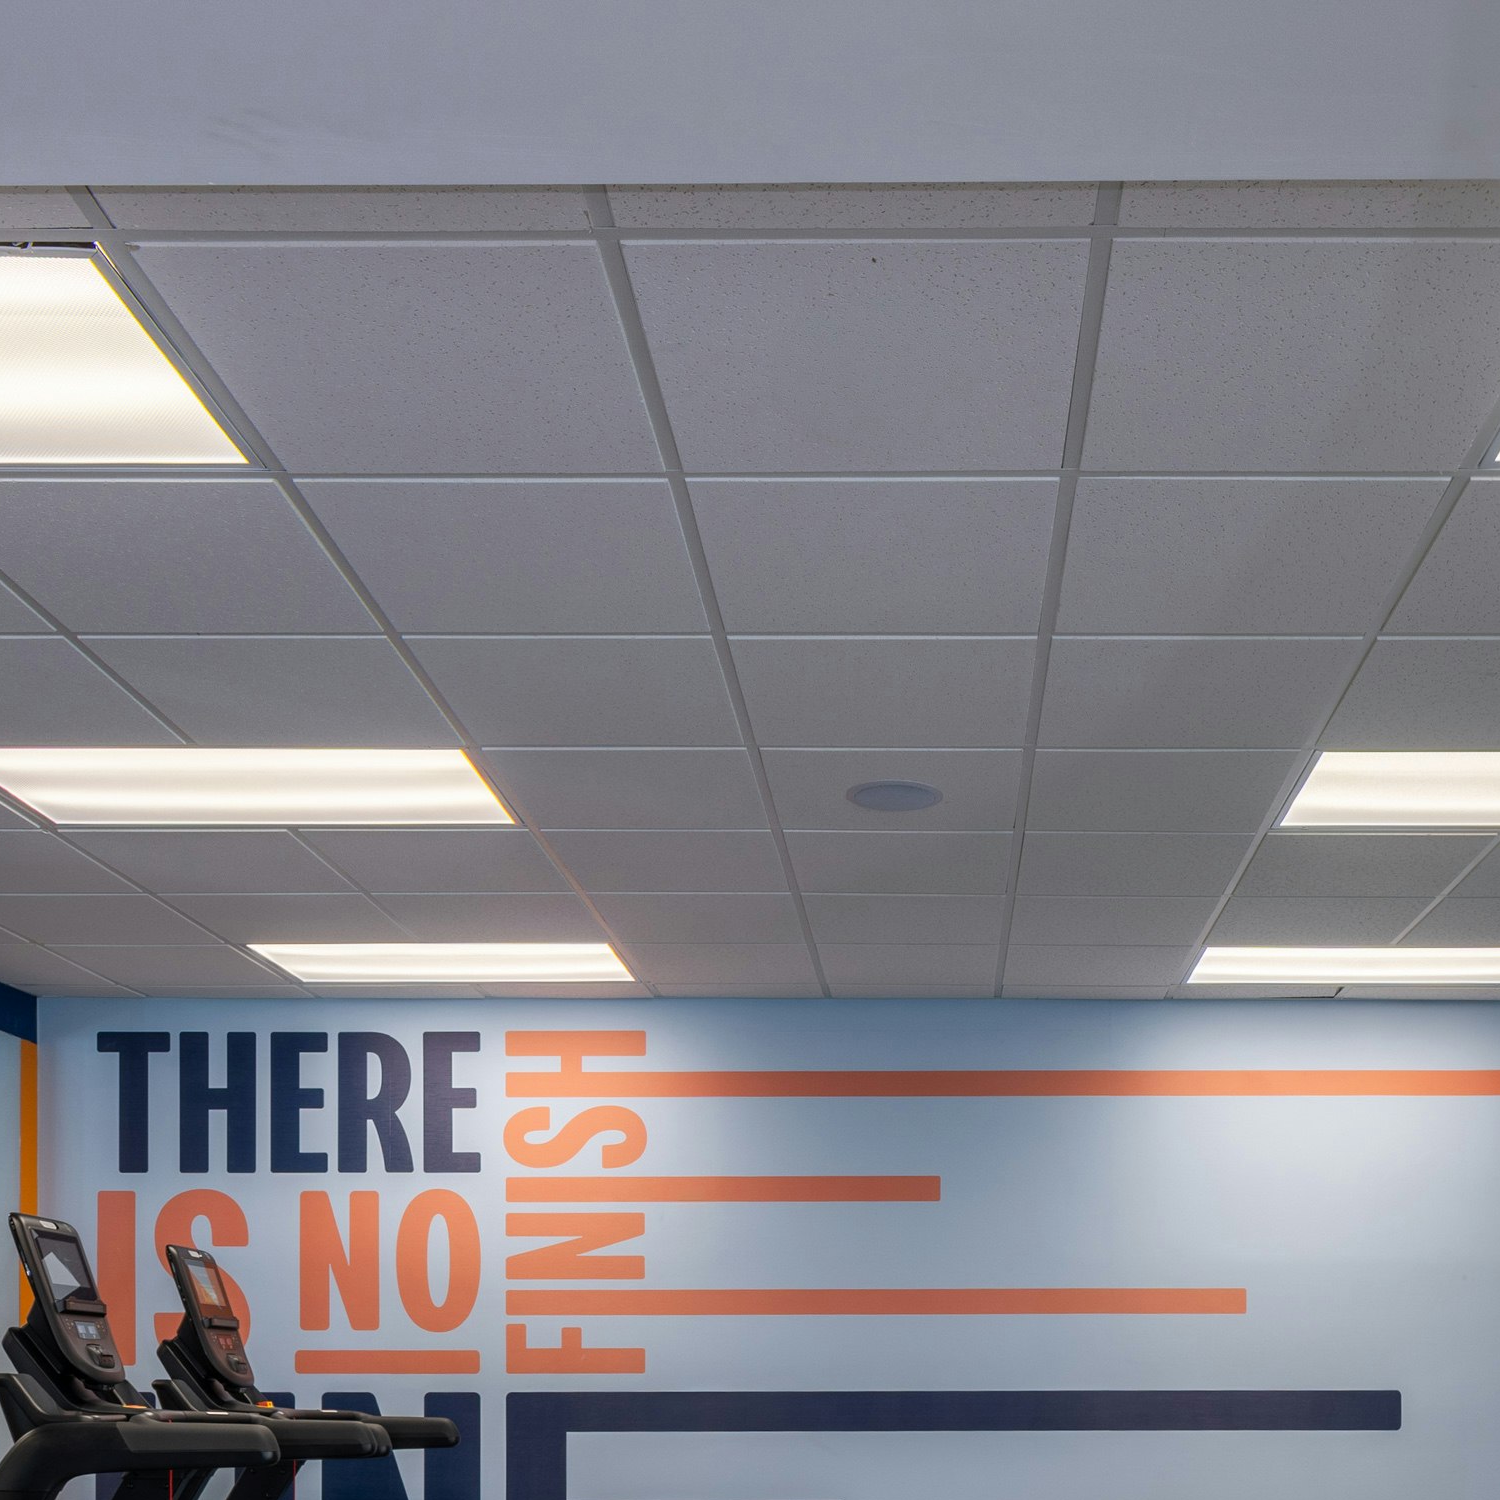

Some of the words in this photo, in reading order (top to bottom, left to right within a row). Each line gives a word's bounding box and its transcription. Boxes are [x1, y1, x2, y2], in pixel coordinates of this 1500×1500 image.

[96, 1031, 481, 1174] THERE
[97, 1189, 251, 1367] IS
[300, 1189, 481, 1334] NO
